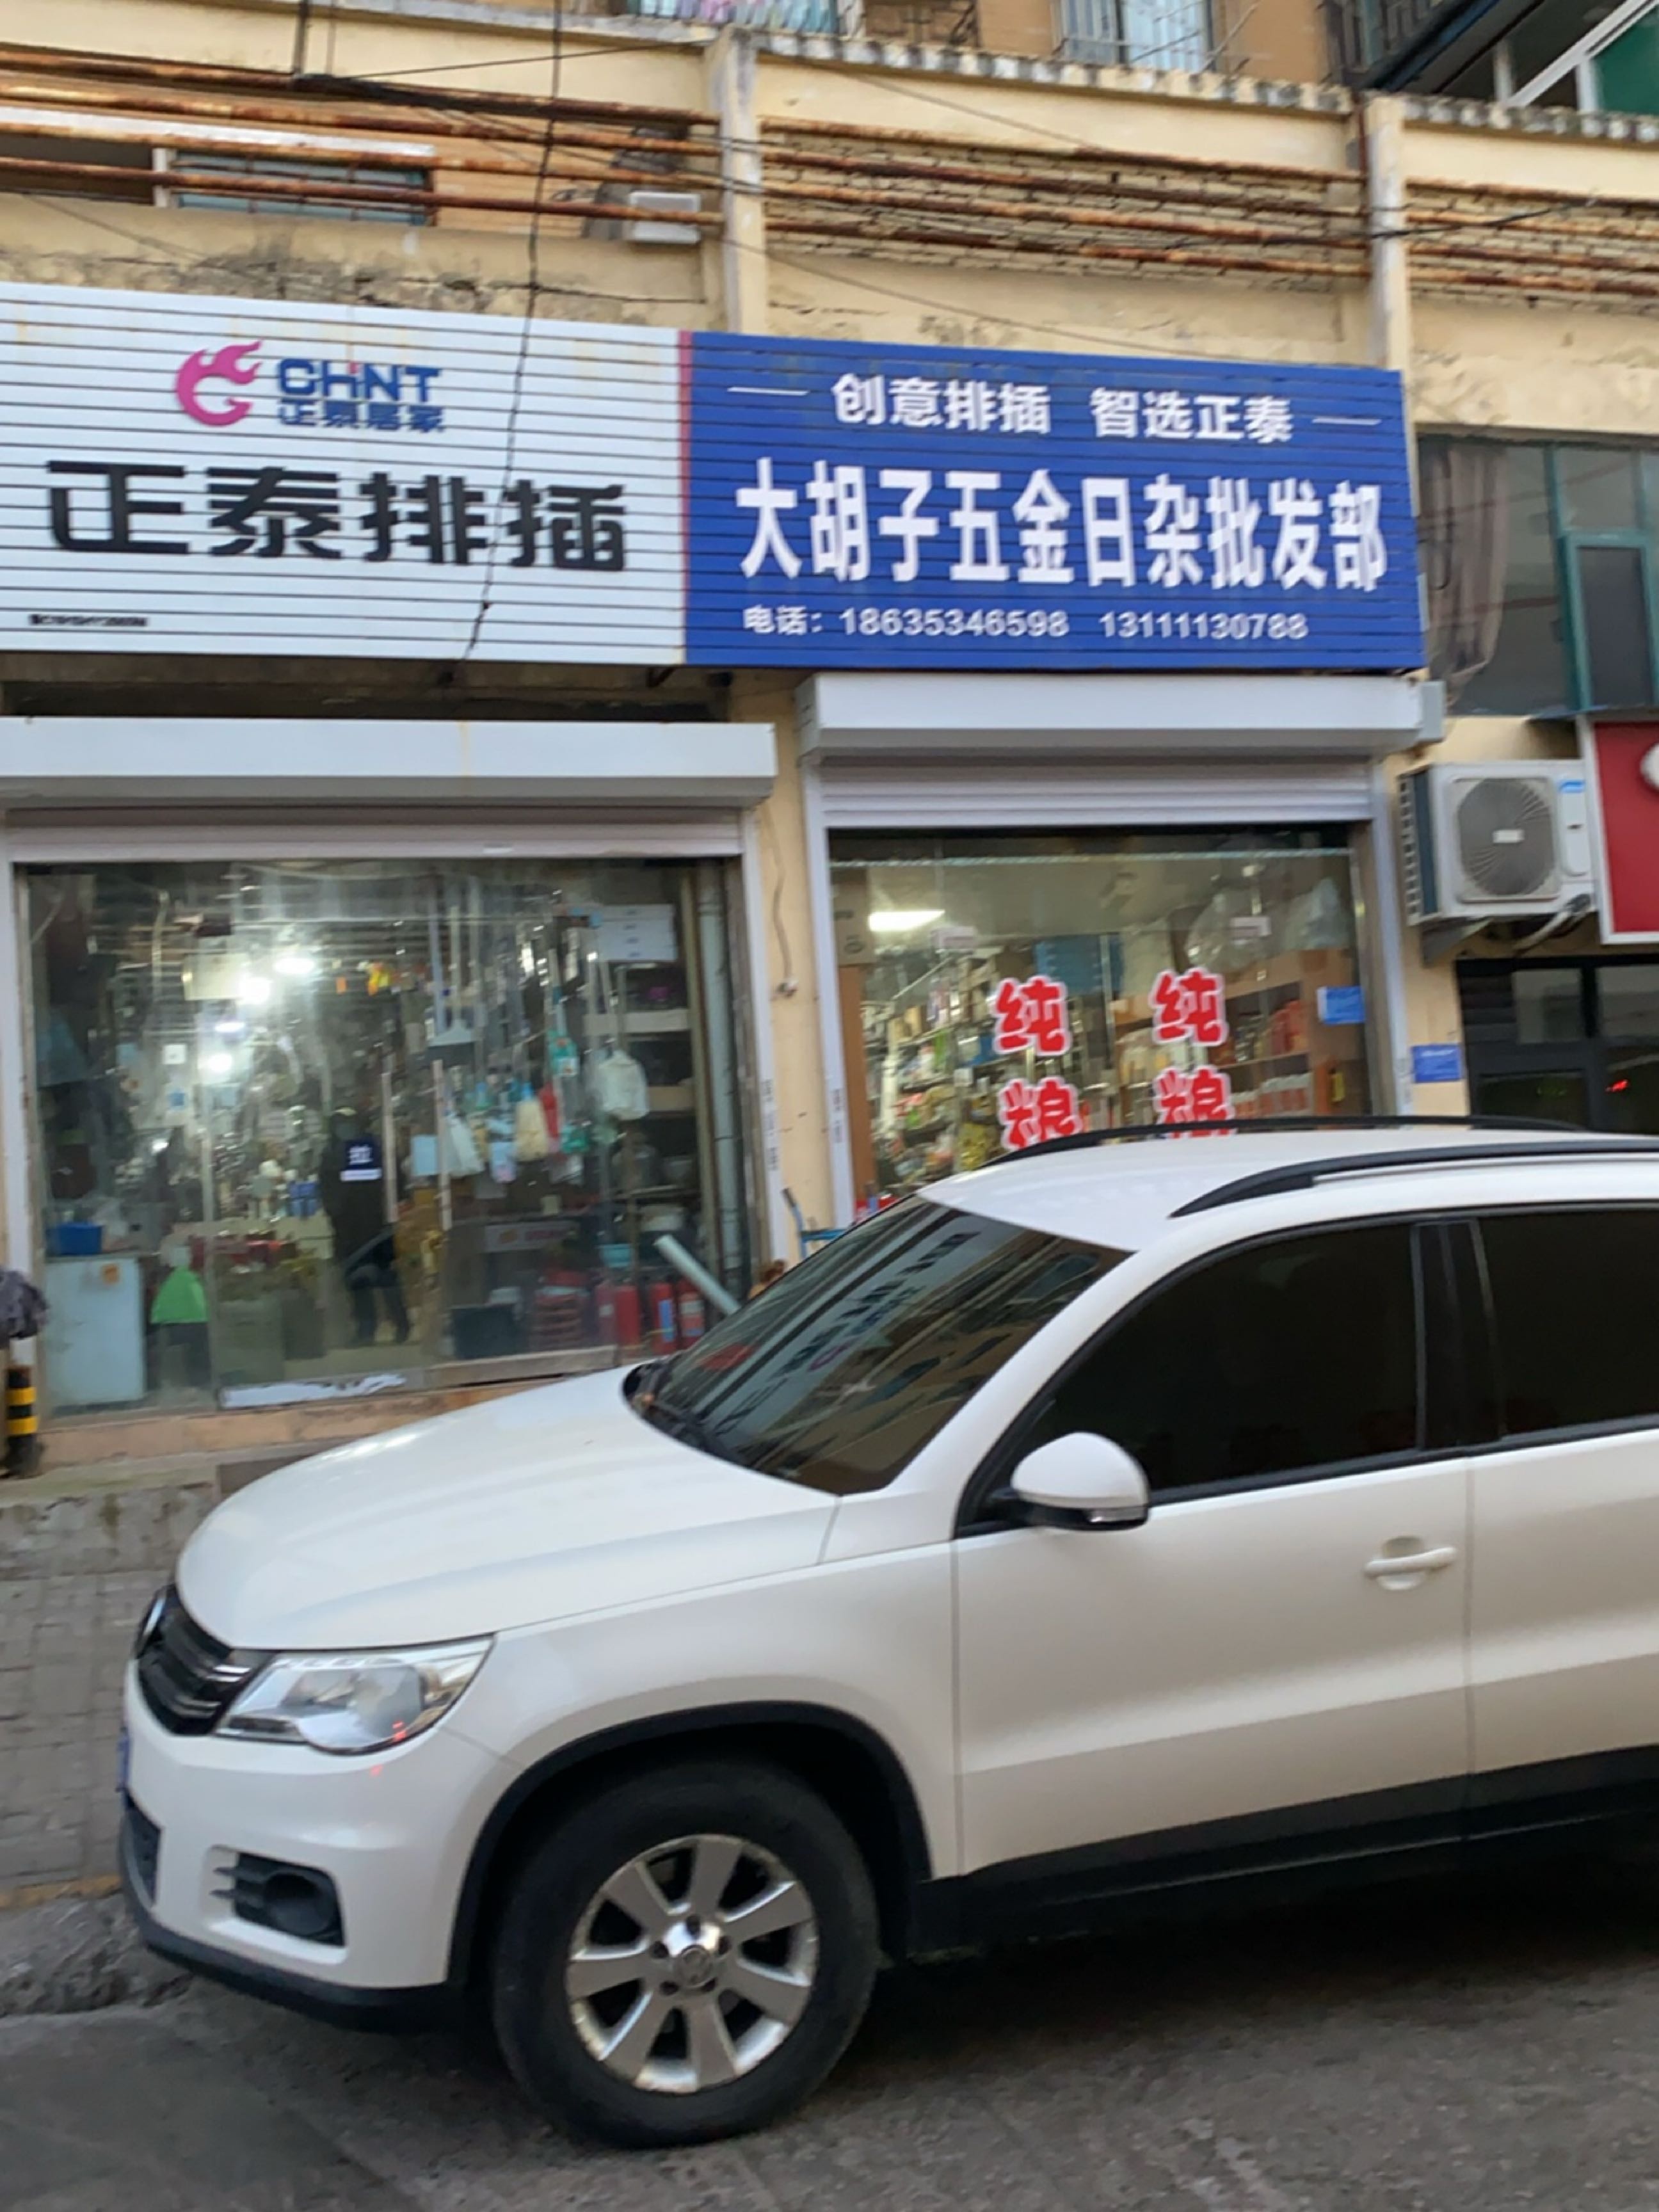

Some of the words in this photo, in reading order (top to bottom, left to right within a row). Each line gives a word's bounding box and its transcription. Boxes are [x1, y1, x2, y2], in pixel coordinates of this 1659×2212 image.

[833, 373, 1051, 434] 创意排插
[1090, 387, 1294, 444] 智选正泰
[47, 460, 625, 571] 正泰排插
[736, 457, 1386, 591] 大胡子五金日杂批发部
[838, 607, 1070, 637] 18635346598
[1100, 612, 1308, 640] 13111130788
